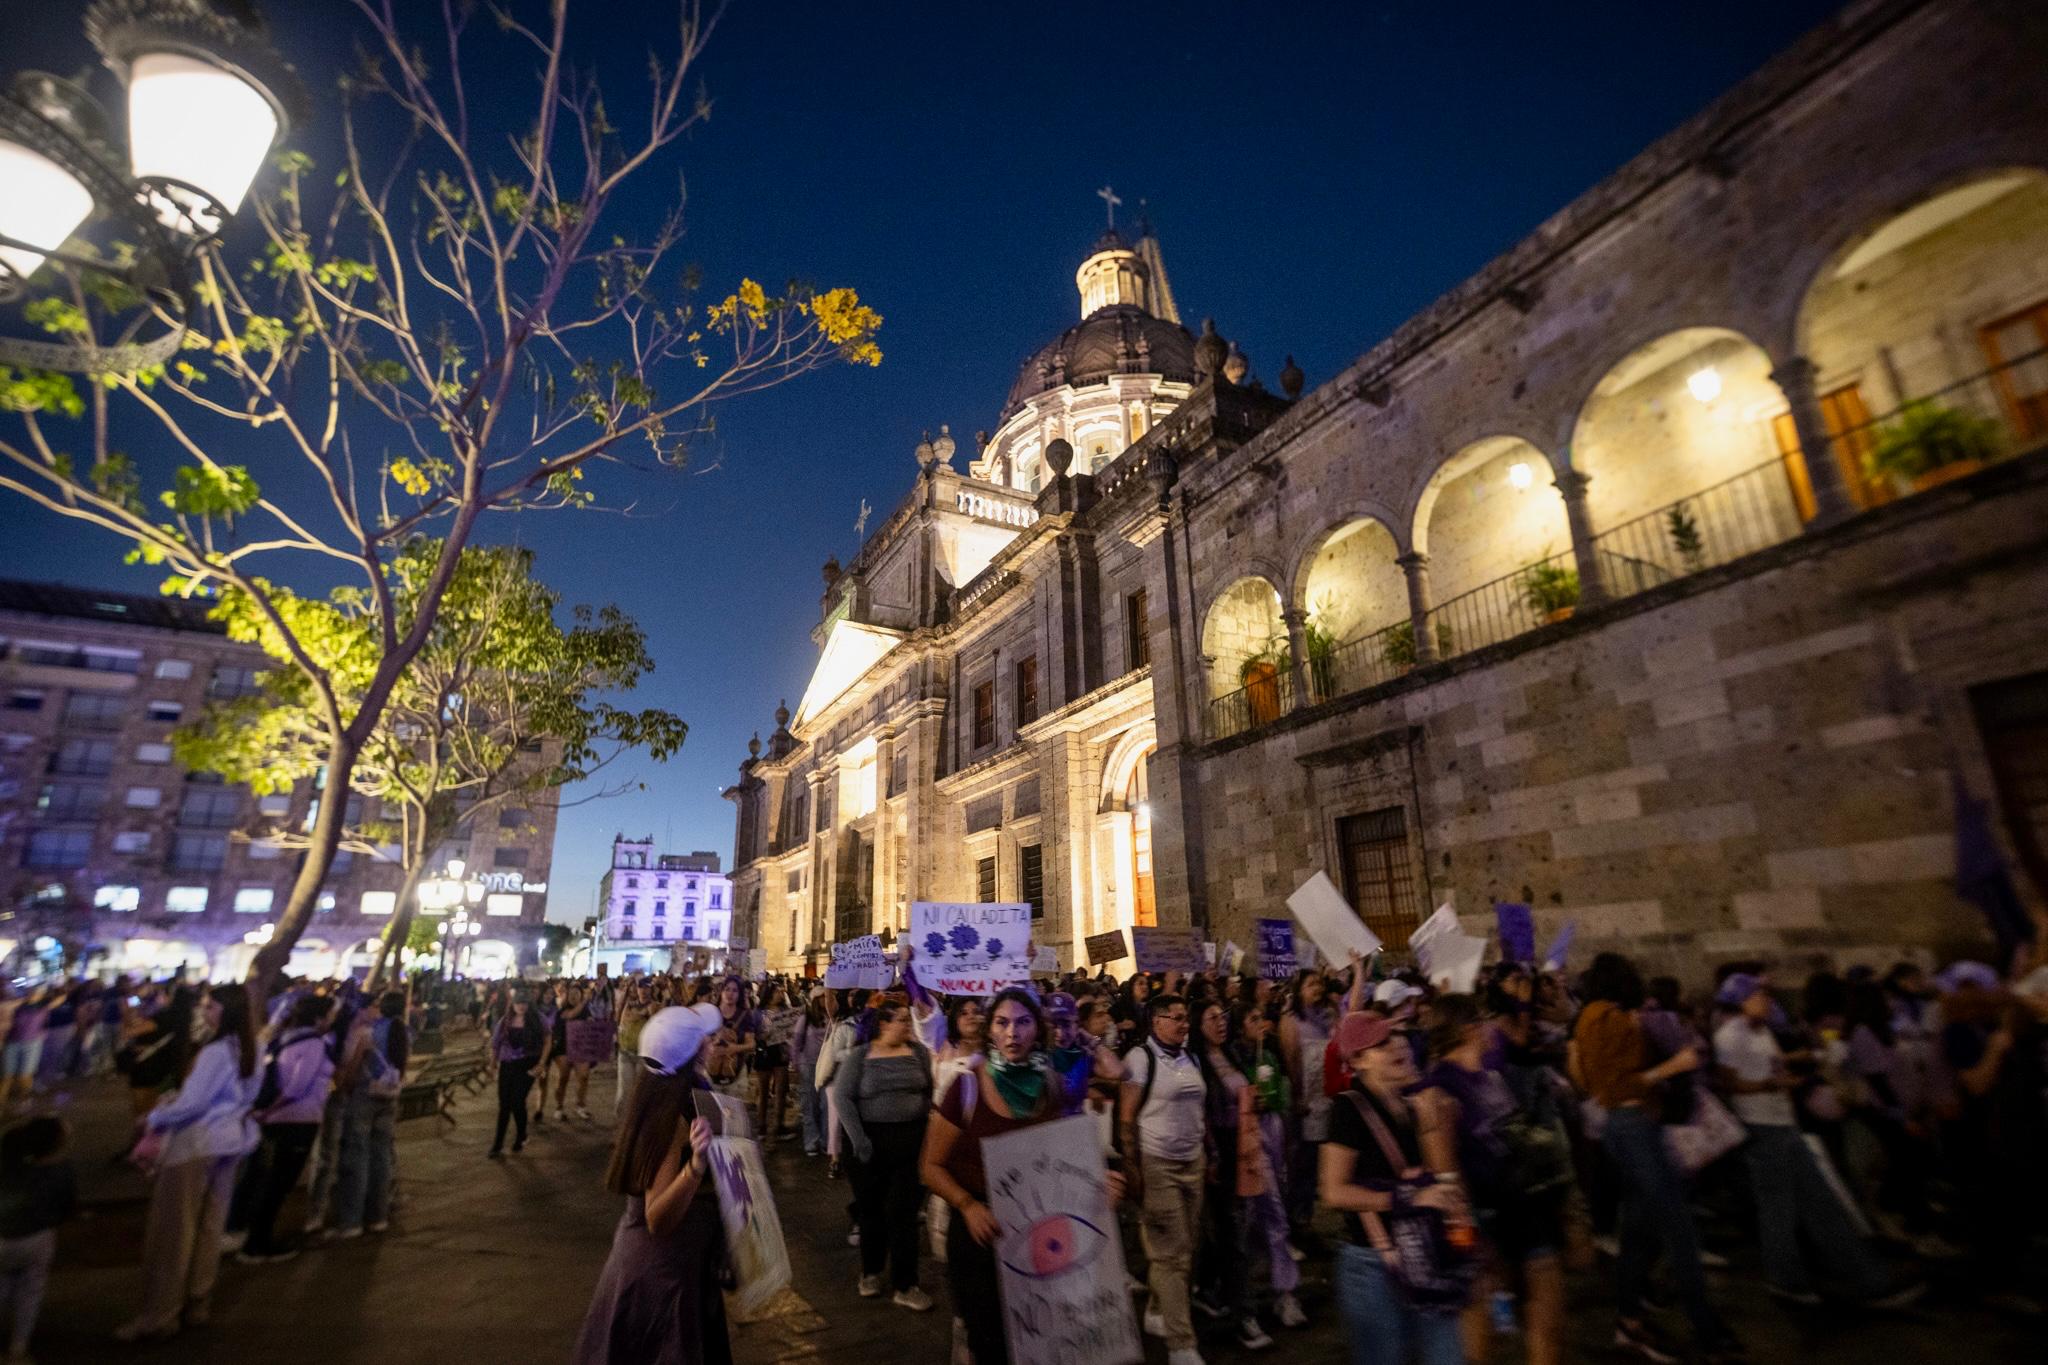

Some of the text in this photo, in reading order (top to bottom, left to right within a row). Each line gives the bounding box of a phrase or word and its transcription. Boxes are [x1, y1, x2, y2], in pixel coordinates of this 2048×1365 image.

[923, 905, 1029, 926] NI CALLADITA
[936, 978, 985, 993] NUNCA
